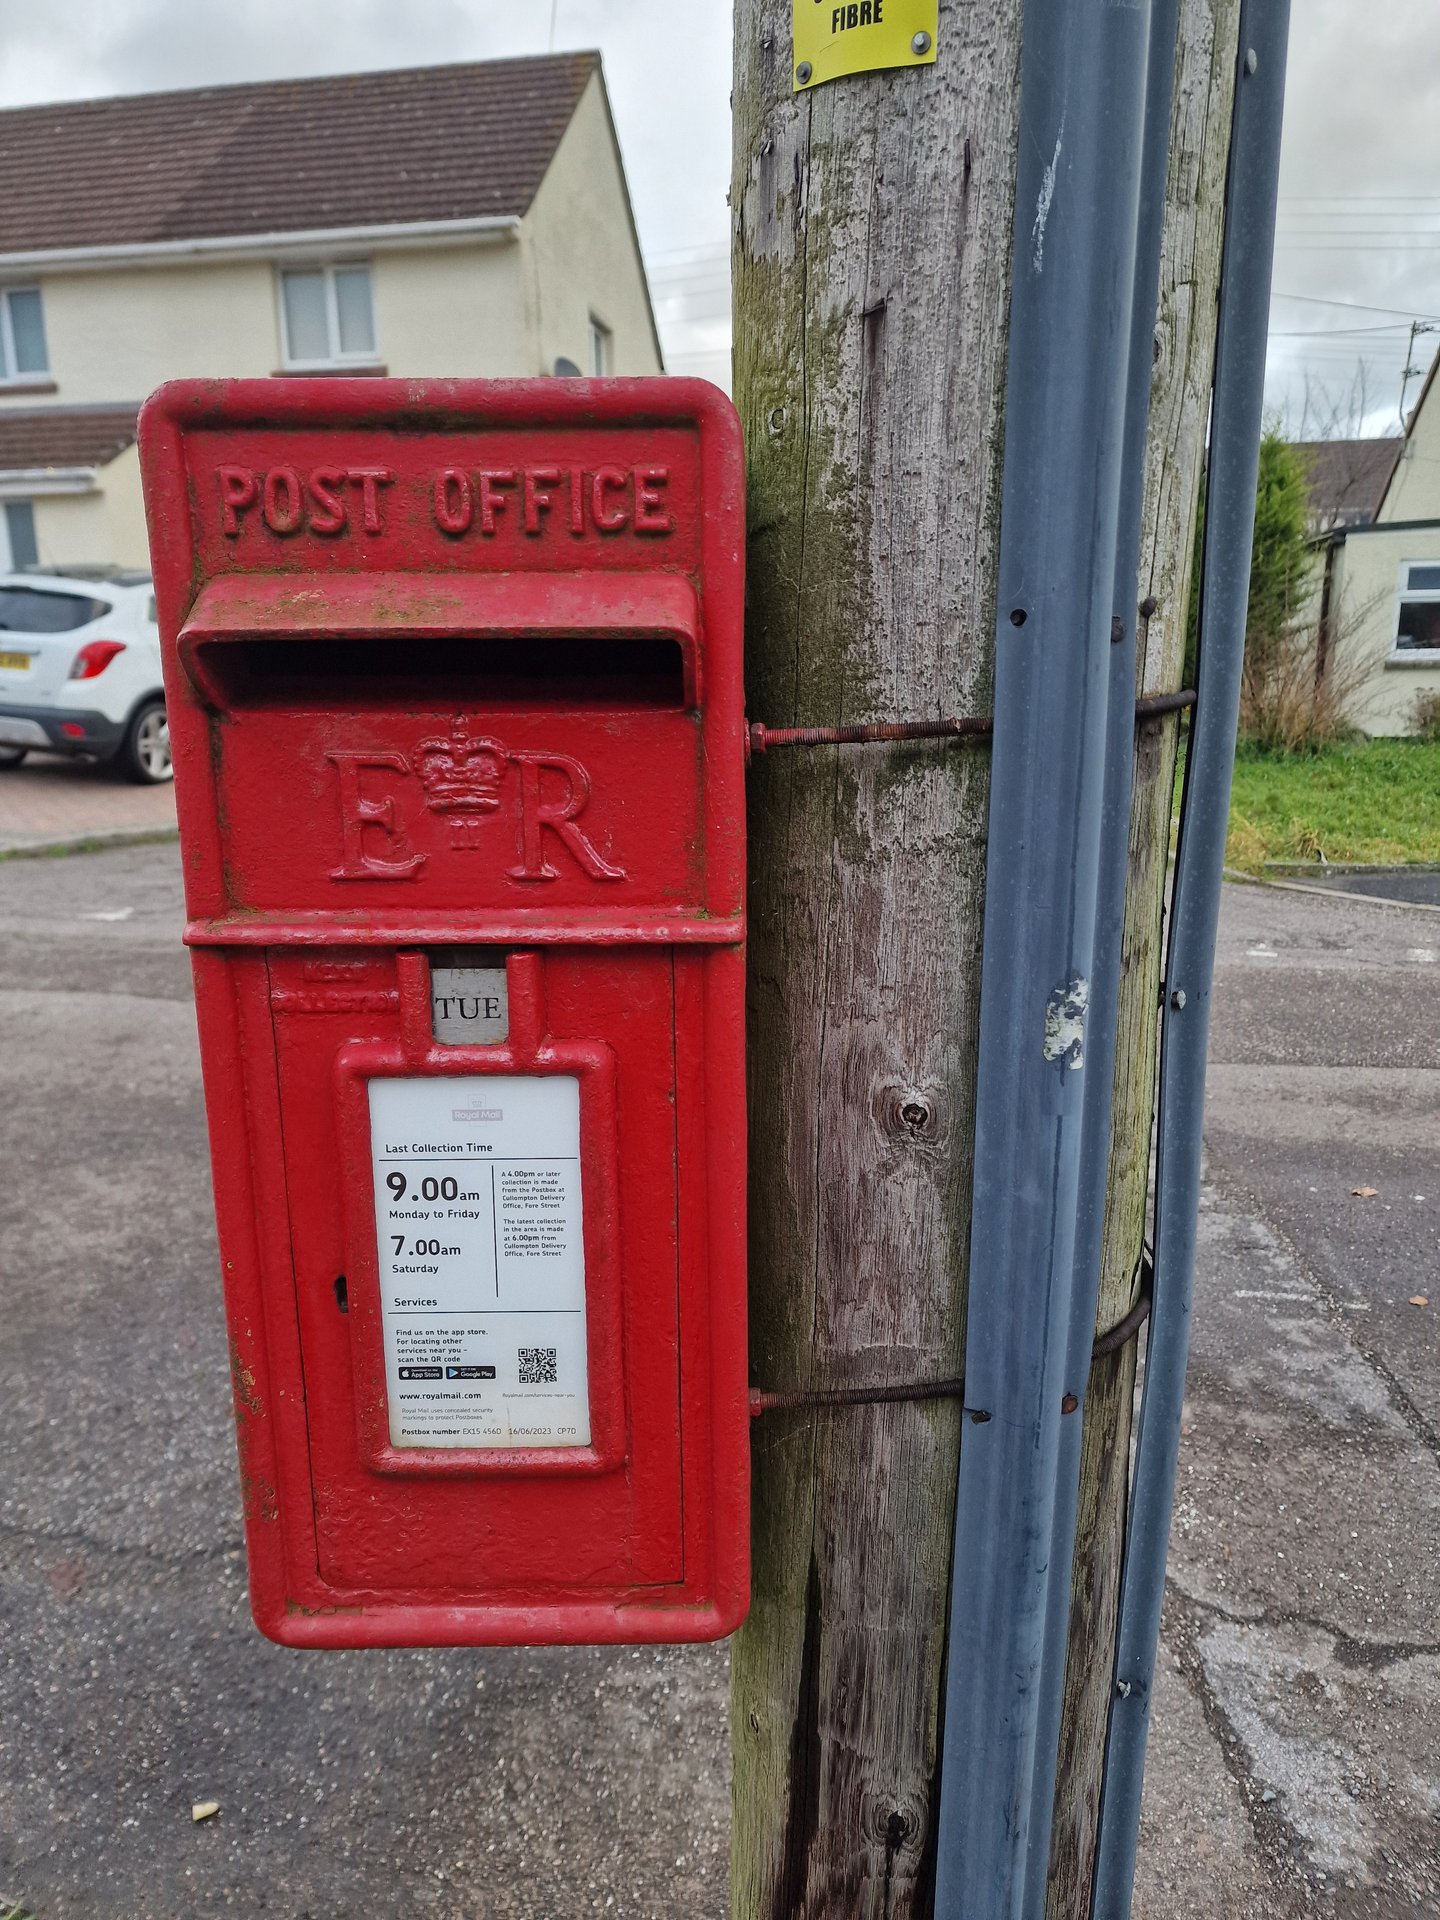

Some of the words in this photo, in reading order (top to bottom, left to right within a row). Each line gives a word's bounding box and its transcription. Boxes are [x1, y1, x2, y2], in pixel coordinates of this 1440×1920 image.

[832, 0, 883, 34] FIBRE
[217, 464, 396, 535] POST
[434, 464, 674, 535] OFFICE
[436, 997, 501, 1020] TUE
[454, 1112, 479, 1121] Royal
[386, 1144, 408, 1153] Last
[412, 1144, 463, 1153] Collection
[466, 1143, 493, 1152] Time
[386, 1172, 480, 1201] 9.00am
[389, 1210, 430, 1220] Monday
[434, 1210, 443, 1219] to
[448, 1209, 480, 1219] Friday
[391, 1236, 461, 1255] 7.00am
[392, 1264, 438, 1274] Saturday
[394, 1298, 437, 1306] Services
